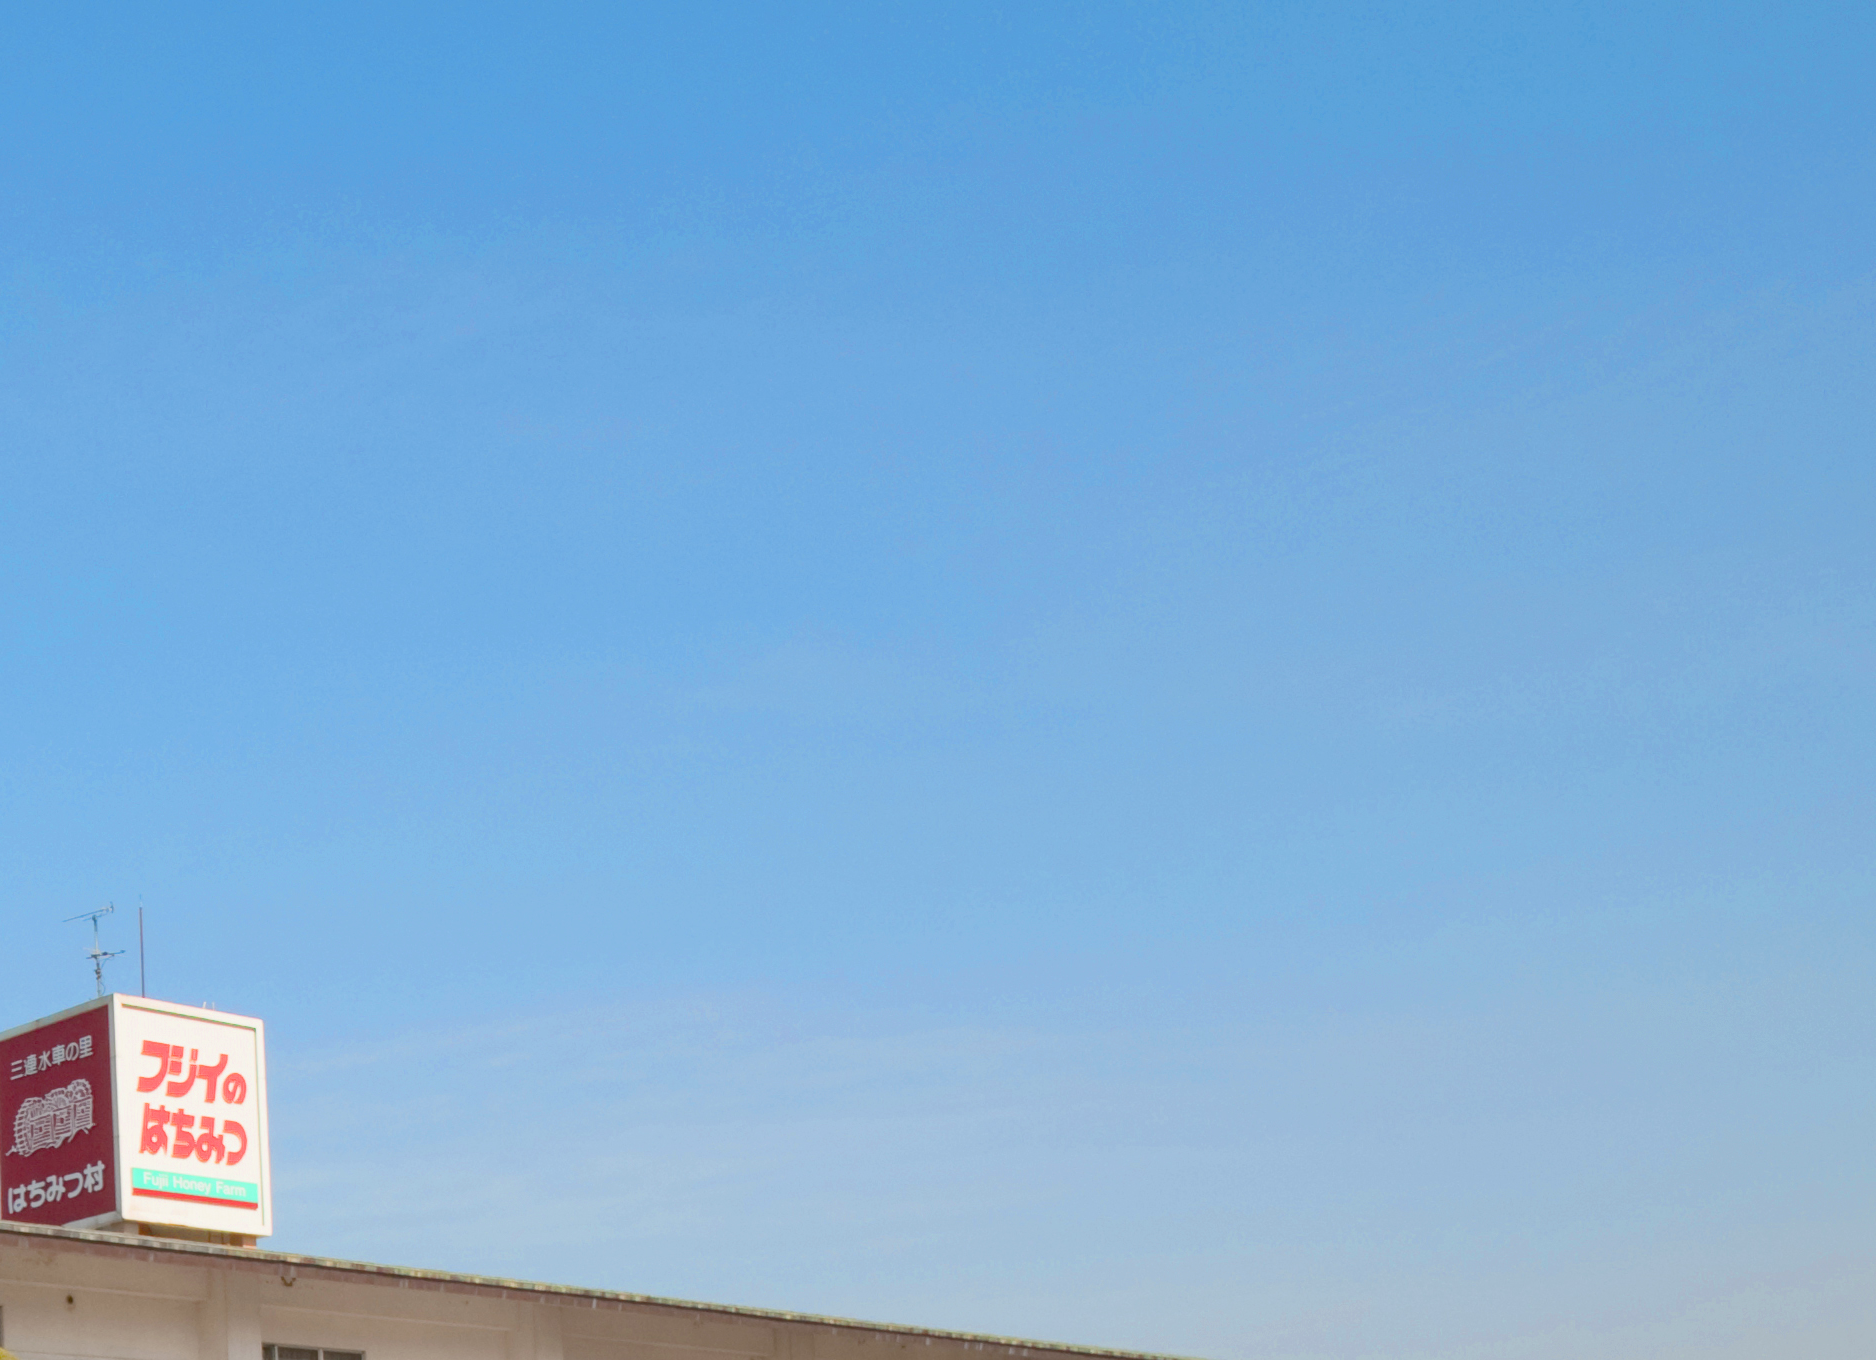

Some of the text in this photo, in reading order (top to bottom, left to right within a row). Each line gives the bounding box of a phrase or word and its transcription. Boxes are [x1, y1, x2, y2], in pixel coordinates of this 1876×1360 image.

[10, 1035, 93, 1080] 三連水車の里
[136, 1039, 247, 1105] フジイの
[139, 1102, 248, 1166] はちみつ
[8, 1160, 105, 1214] はちみつ村
[143, 1171, 247, 1197] Fujii Honey Farm
